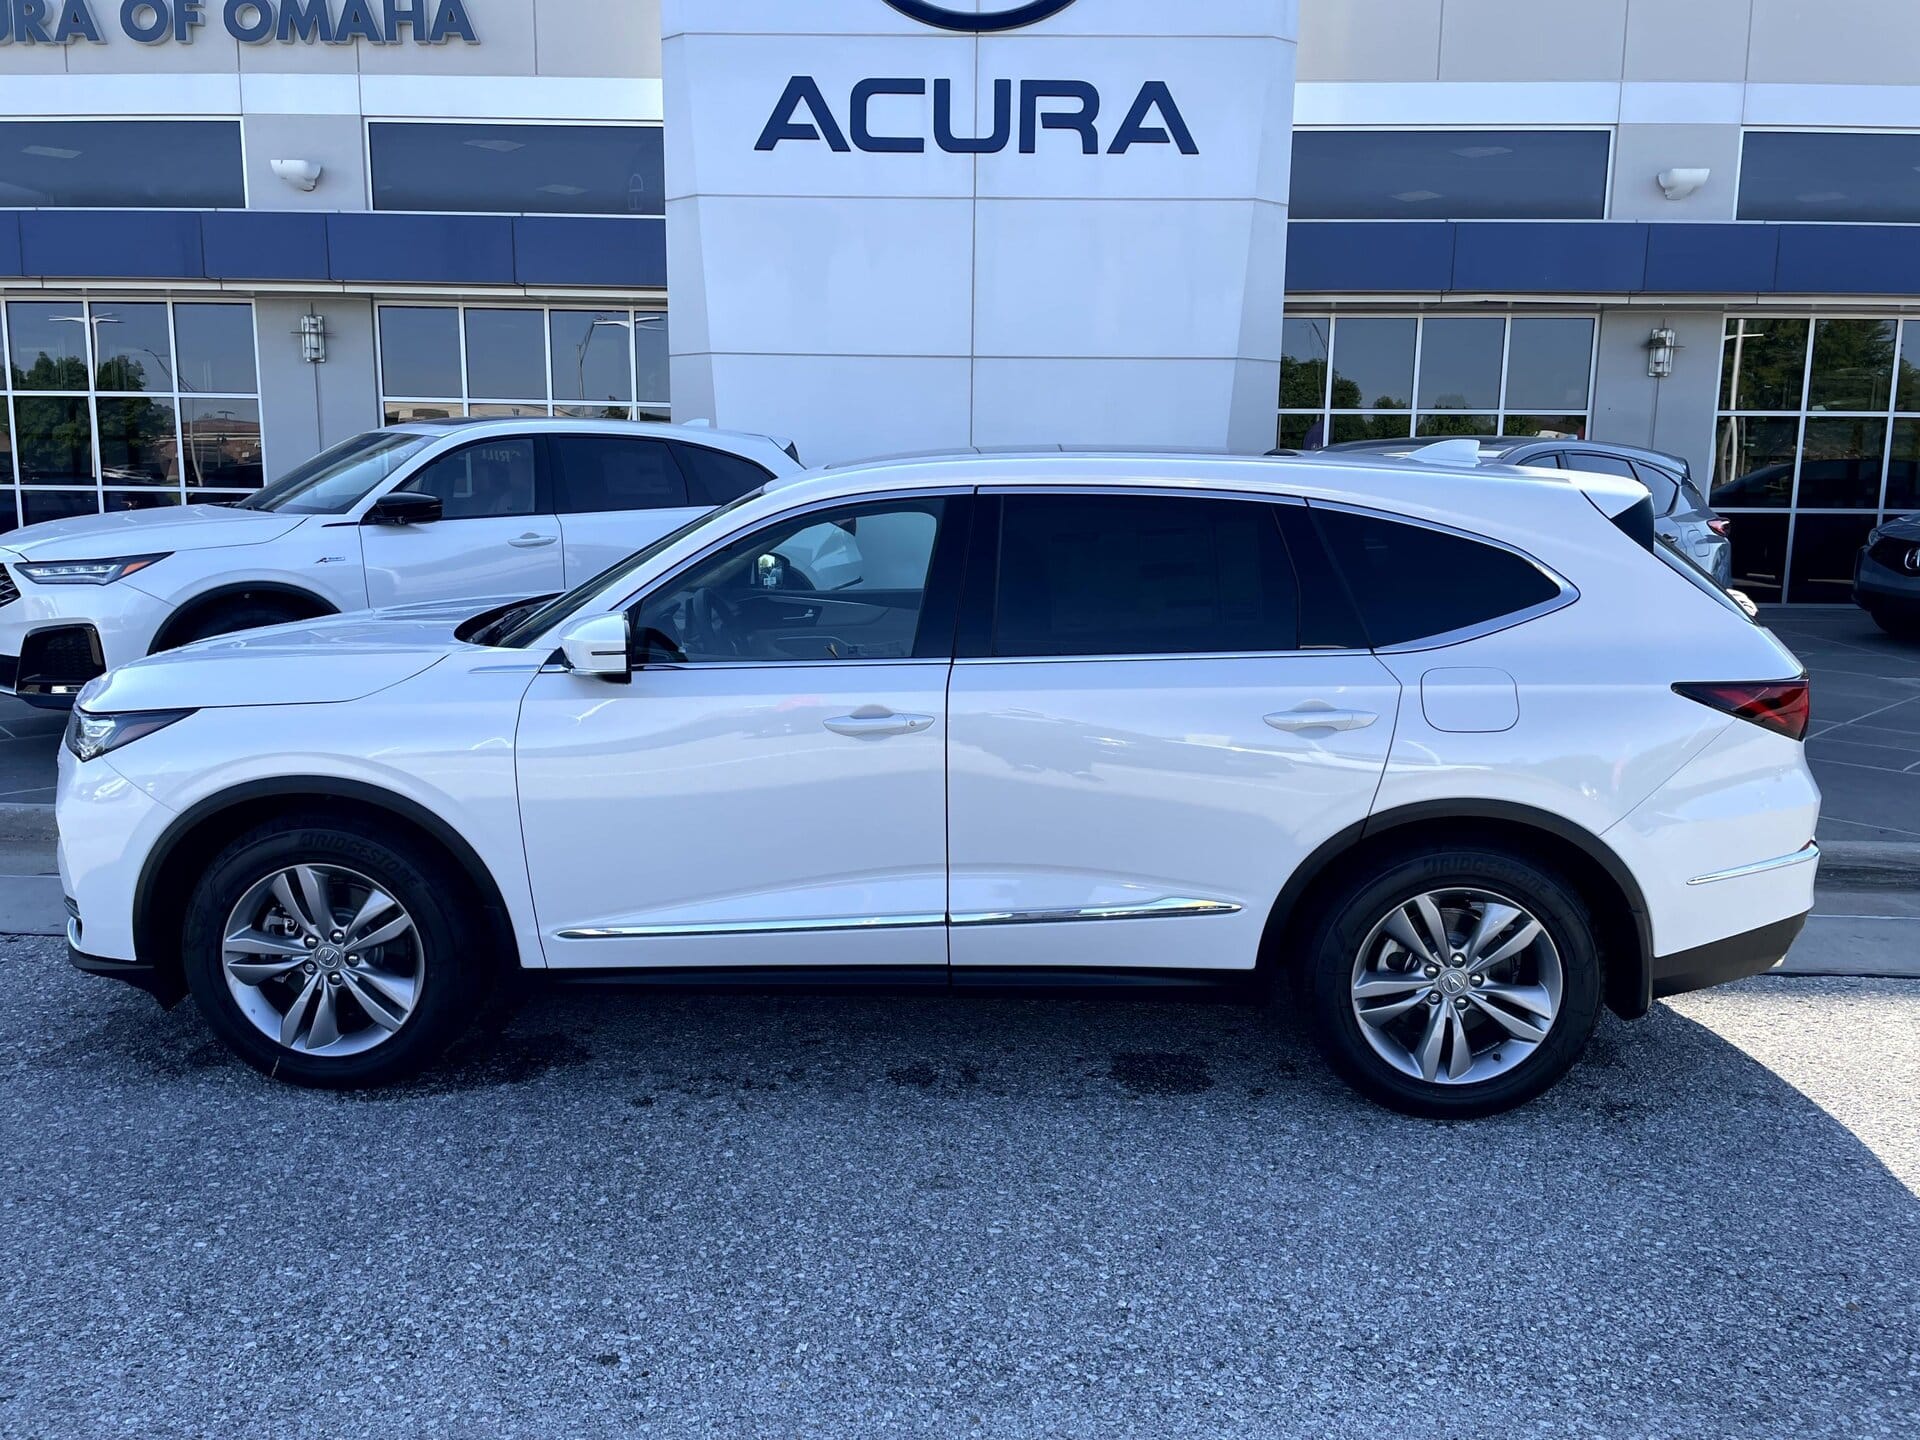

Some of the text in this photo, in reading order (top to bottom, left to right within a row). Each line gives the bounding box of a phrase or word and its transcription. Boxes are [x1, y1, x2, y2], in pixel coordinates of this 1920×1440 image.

[119, 0, 202, 44] OF
[223, 0, 478, 45] OMAHA
[753, 75, 1199, 154] ACURA
